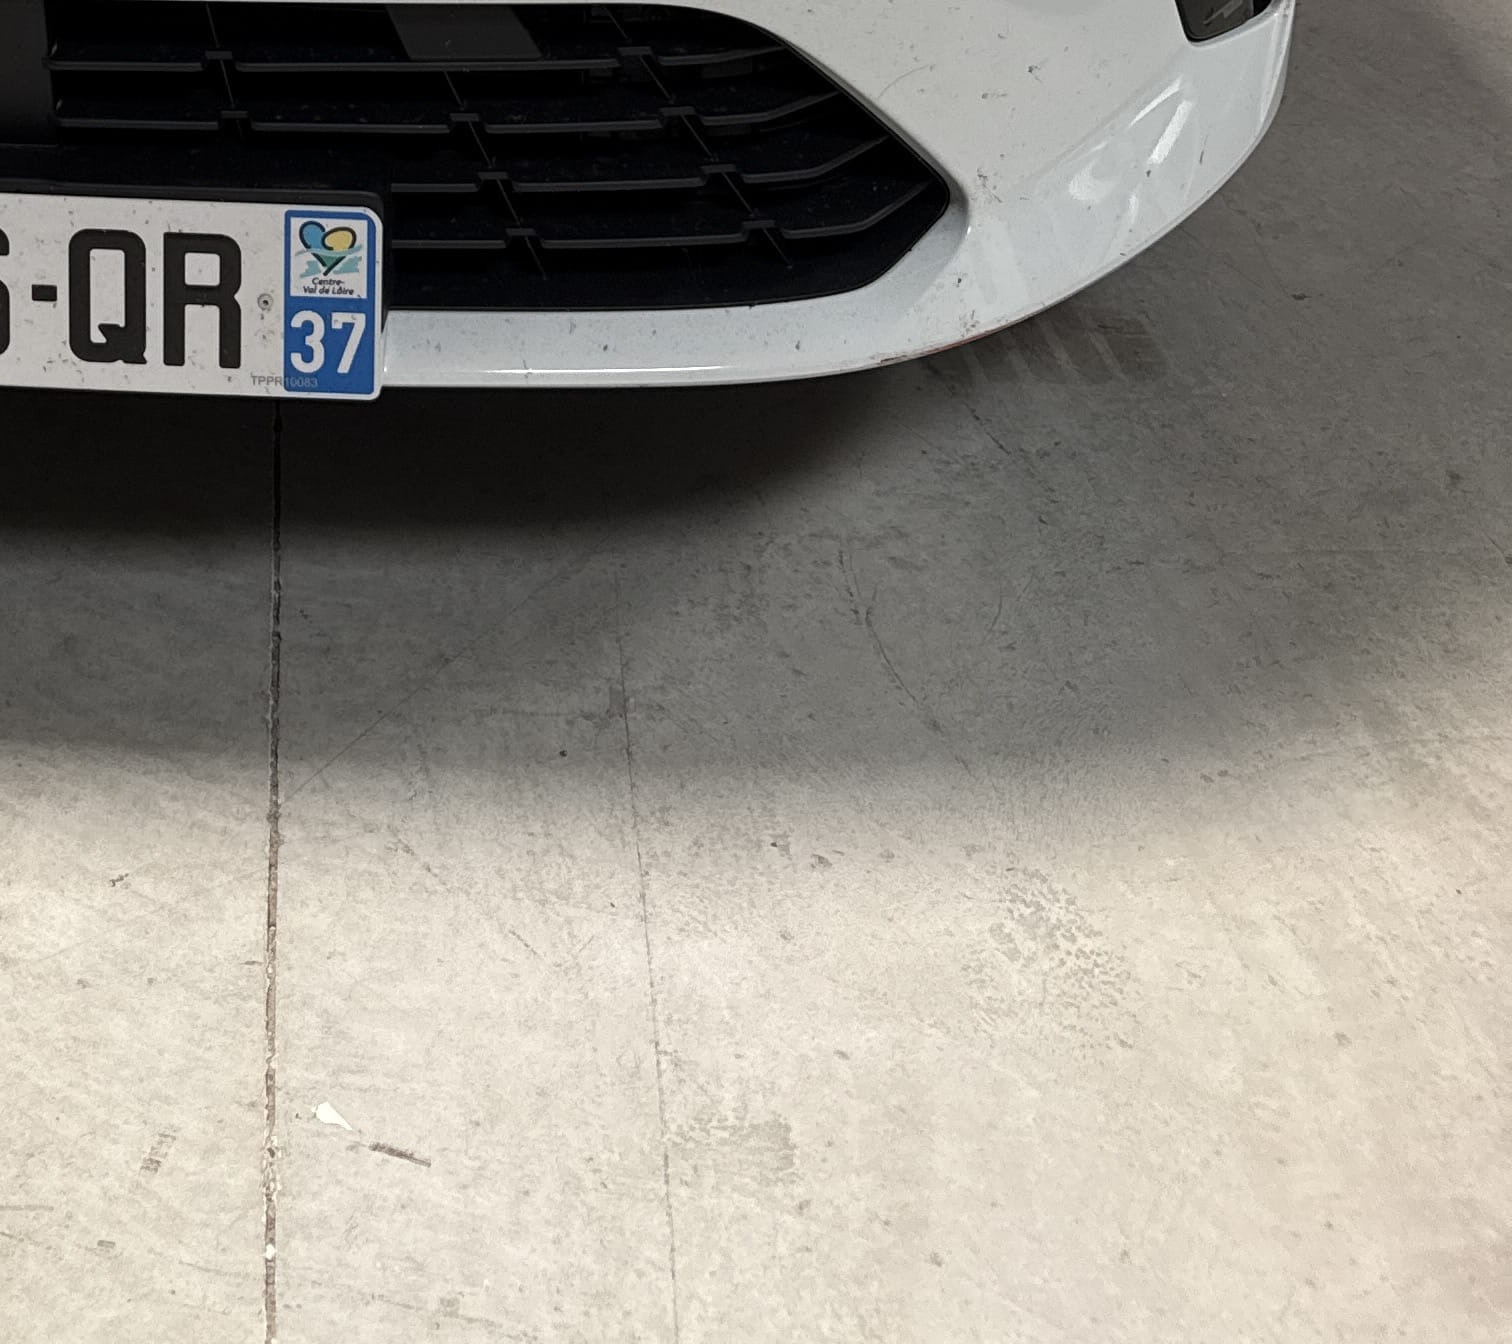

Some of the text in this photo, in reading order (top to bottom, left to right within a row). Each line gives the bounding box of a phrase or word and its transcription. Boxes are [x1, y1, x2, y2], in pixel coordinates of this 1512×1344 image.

[303, 285, 317, 294] Val
[318, 286, 330, 294] de
[291, 311, 366, 373] 37
